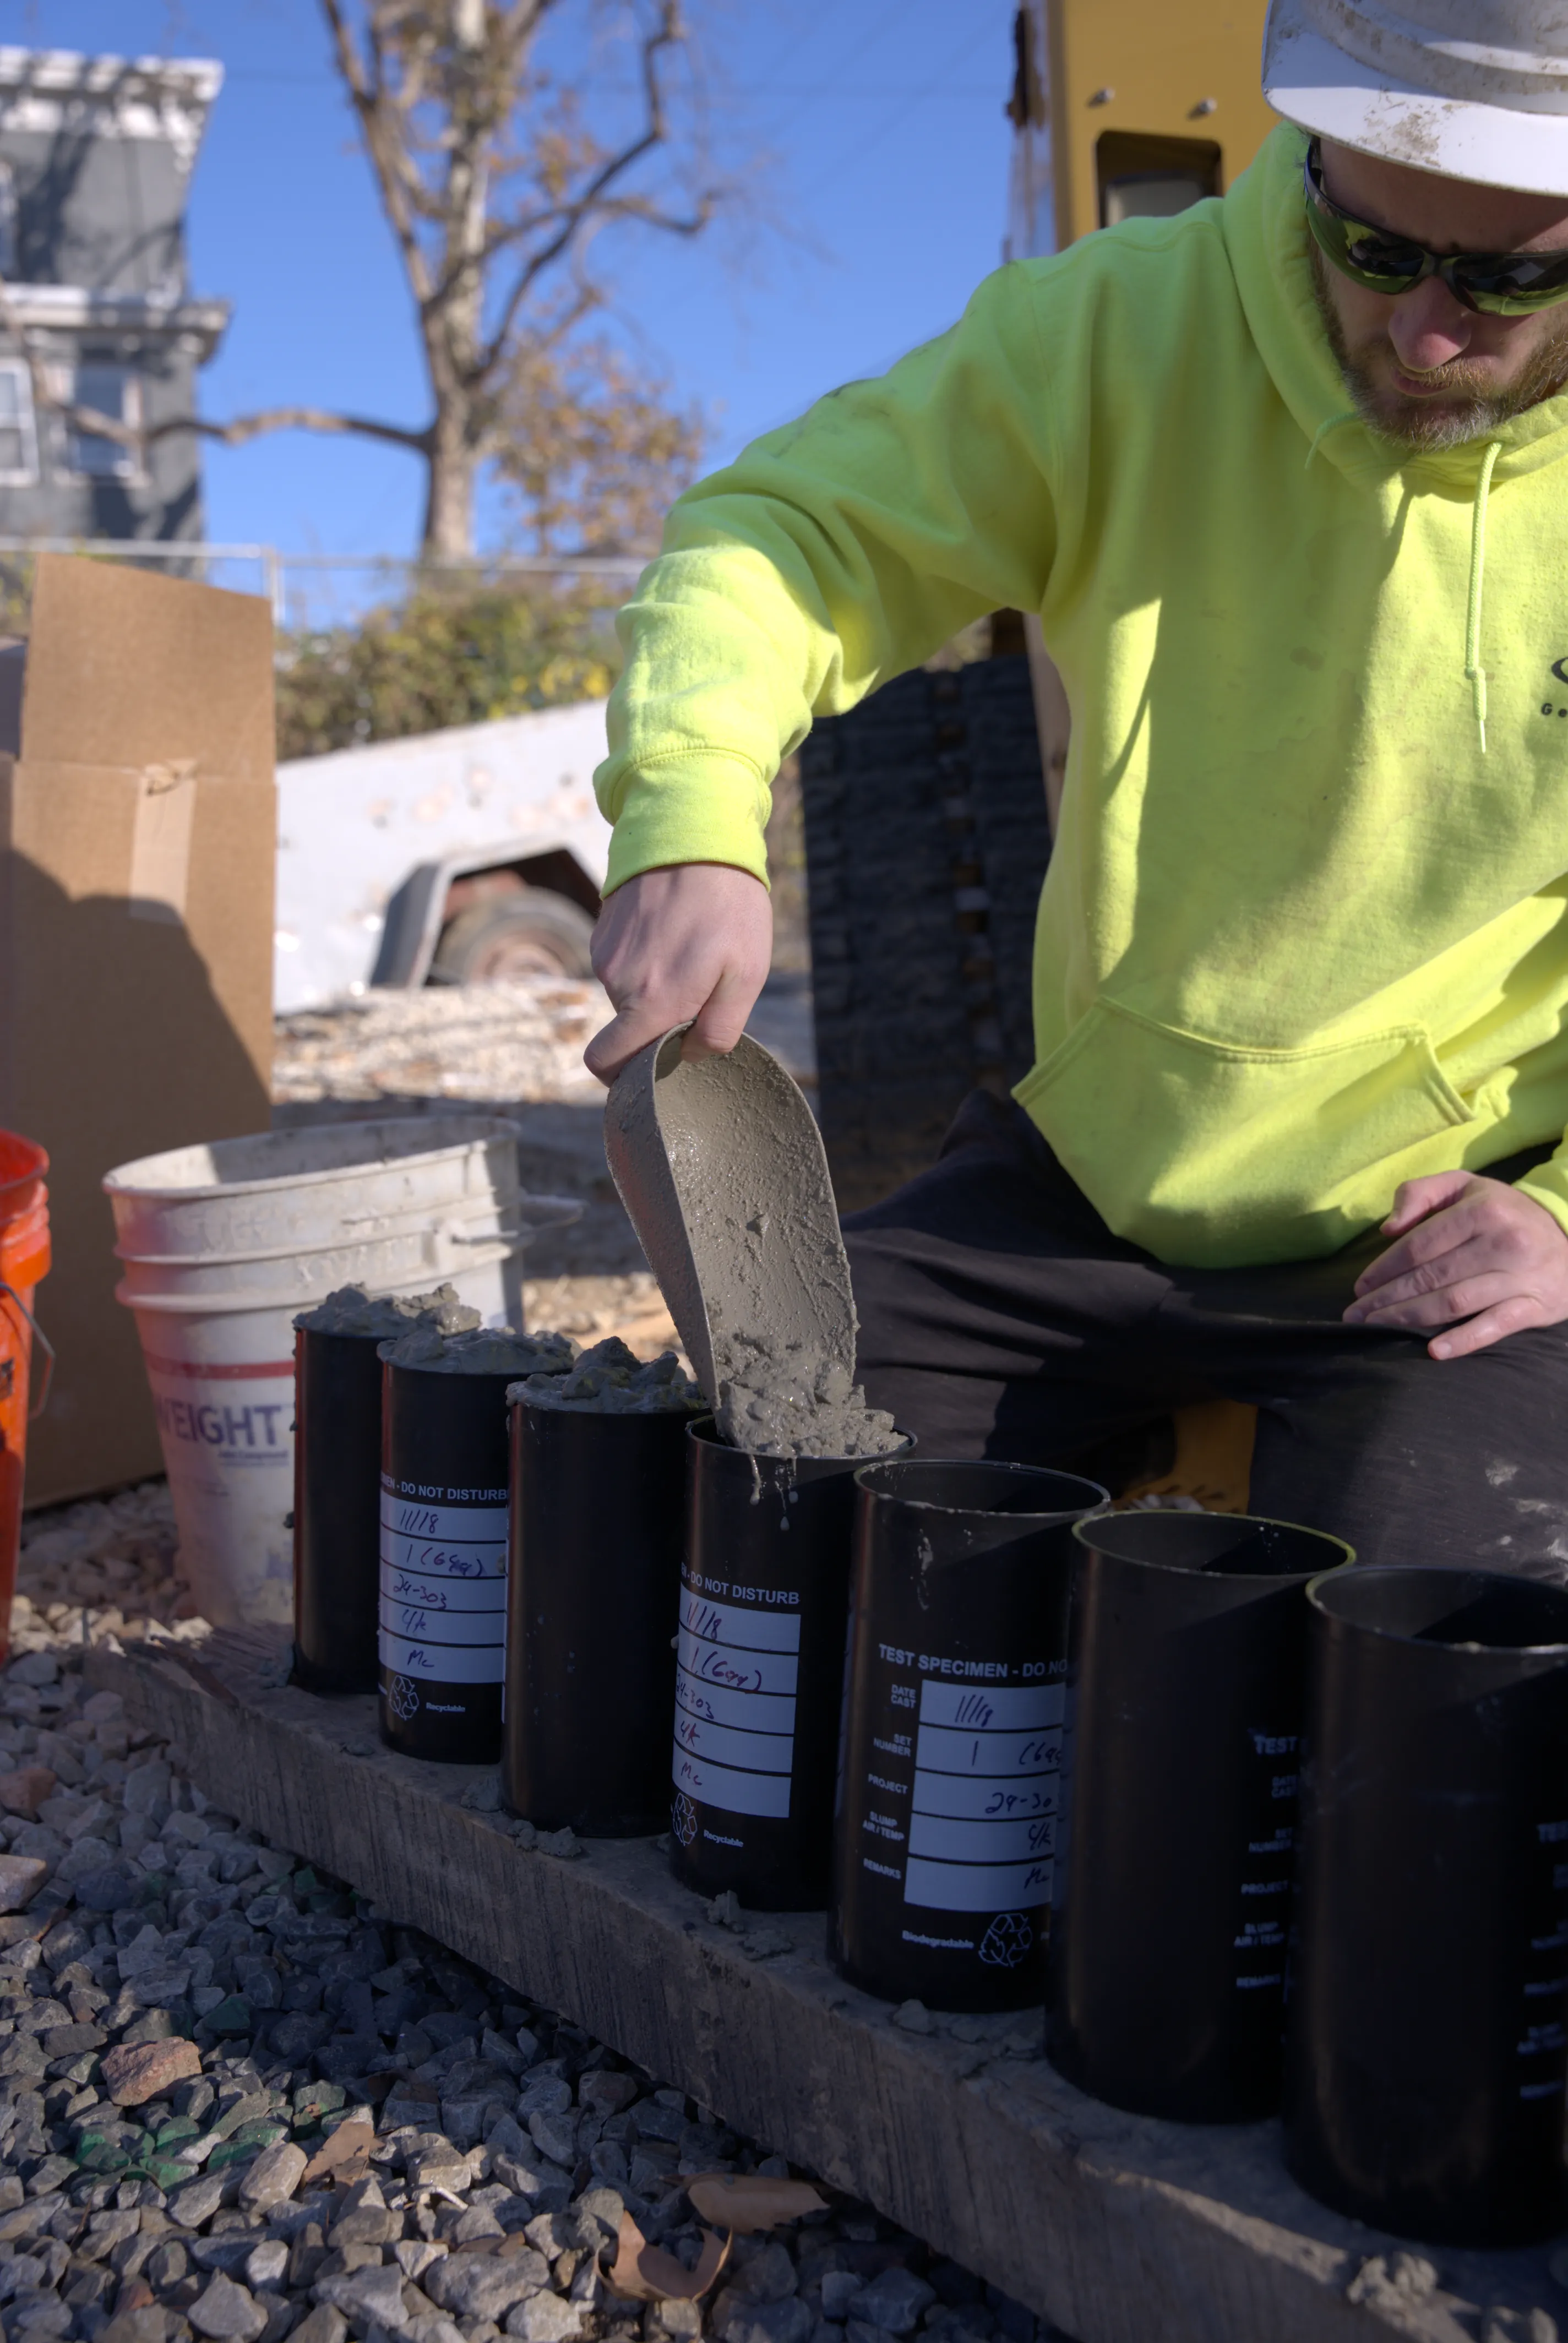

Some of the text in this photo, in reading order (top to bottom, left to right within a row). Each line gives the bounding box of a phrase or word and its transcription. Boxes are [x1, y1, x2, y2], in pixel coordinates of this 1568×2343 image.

[401, 1480, 416, 1495] DO
[418, 1485, 444, 1499] NOT
[447, 1489, 508, 1501] DISTURB
[690, 1570, 703, 1588] DO
[705, 1577, 729, 1595] NOT
[732, 1584, 800, 1605] DISTURB
[878, 1642, 916, 1667] TEST
[917, 1654, 1009, 1679] SPECIMEN
[1021, 1662, 1046, 1678] DO
[1047, 1658, 1068, 1675] NO
[891, 1683, 917, 1699] DATE
[425, 1702, 466, 1713] Recyclable
[890, 1694, 917, 1710] CAST
[873, 1737, 912, 1757] NUMBER
[894, 1733, 913, 1747] SET
[1253, 1735, 1298, 1756] TEST
[867, 1773, 908, 1795] PROJECT
[869, 1810, 898, 1828] SLUMP
[703, 1828, 744, 1848] Recyclable
[862, 1819, 875, 1833] AIR
[880, 1826, 906, 1842] TEMP
[863, 1857, 902, 1880] REMARKS
[1240, 1878, 1289, 1896] PROJECT
[901, 1929, 974, 1950] Biodegradable
